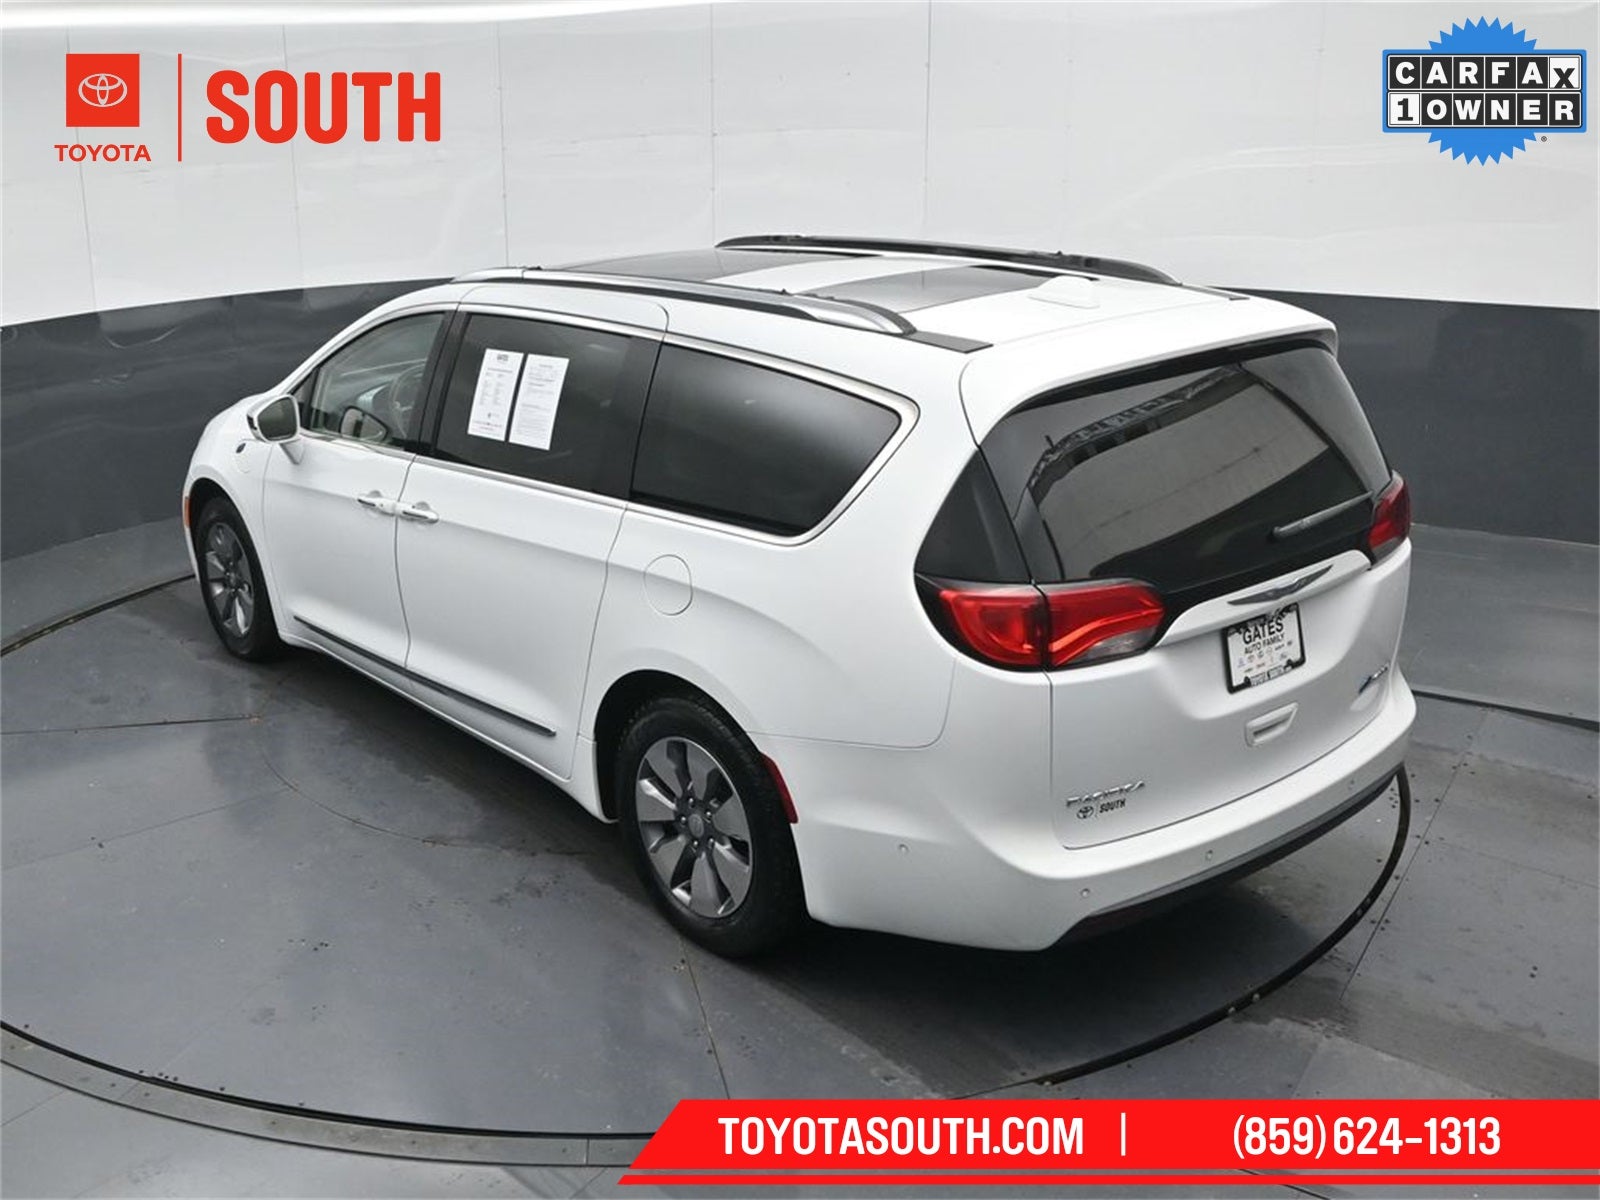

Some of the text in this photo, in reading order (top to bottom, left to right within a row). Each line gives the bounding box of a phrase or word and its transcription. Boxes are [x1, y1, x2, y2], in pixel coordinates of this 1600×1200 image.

[1243, 617, 1284, 645] GATES
[1244, 641, 1262, 654] AUTO
[1099, 798, 1126, 813] SOUTH
